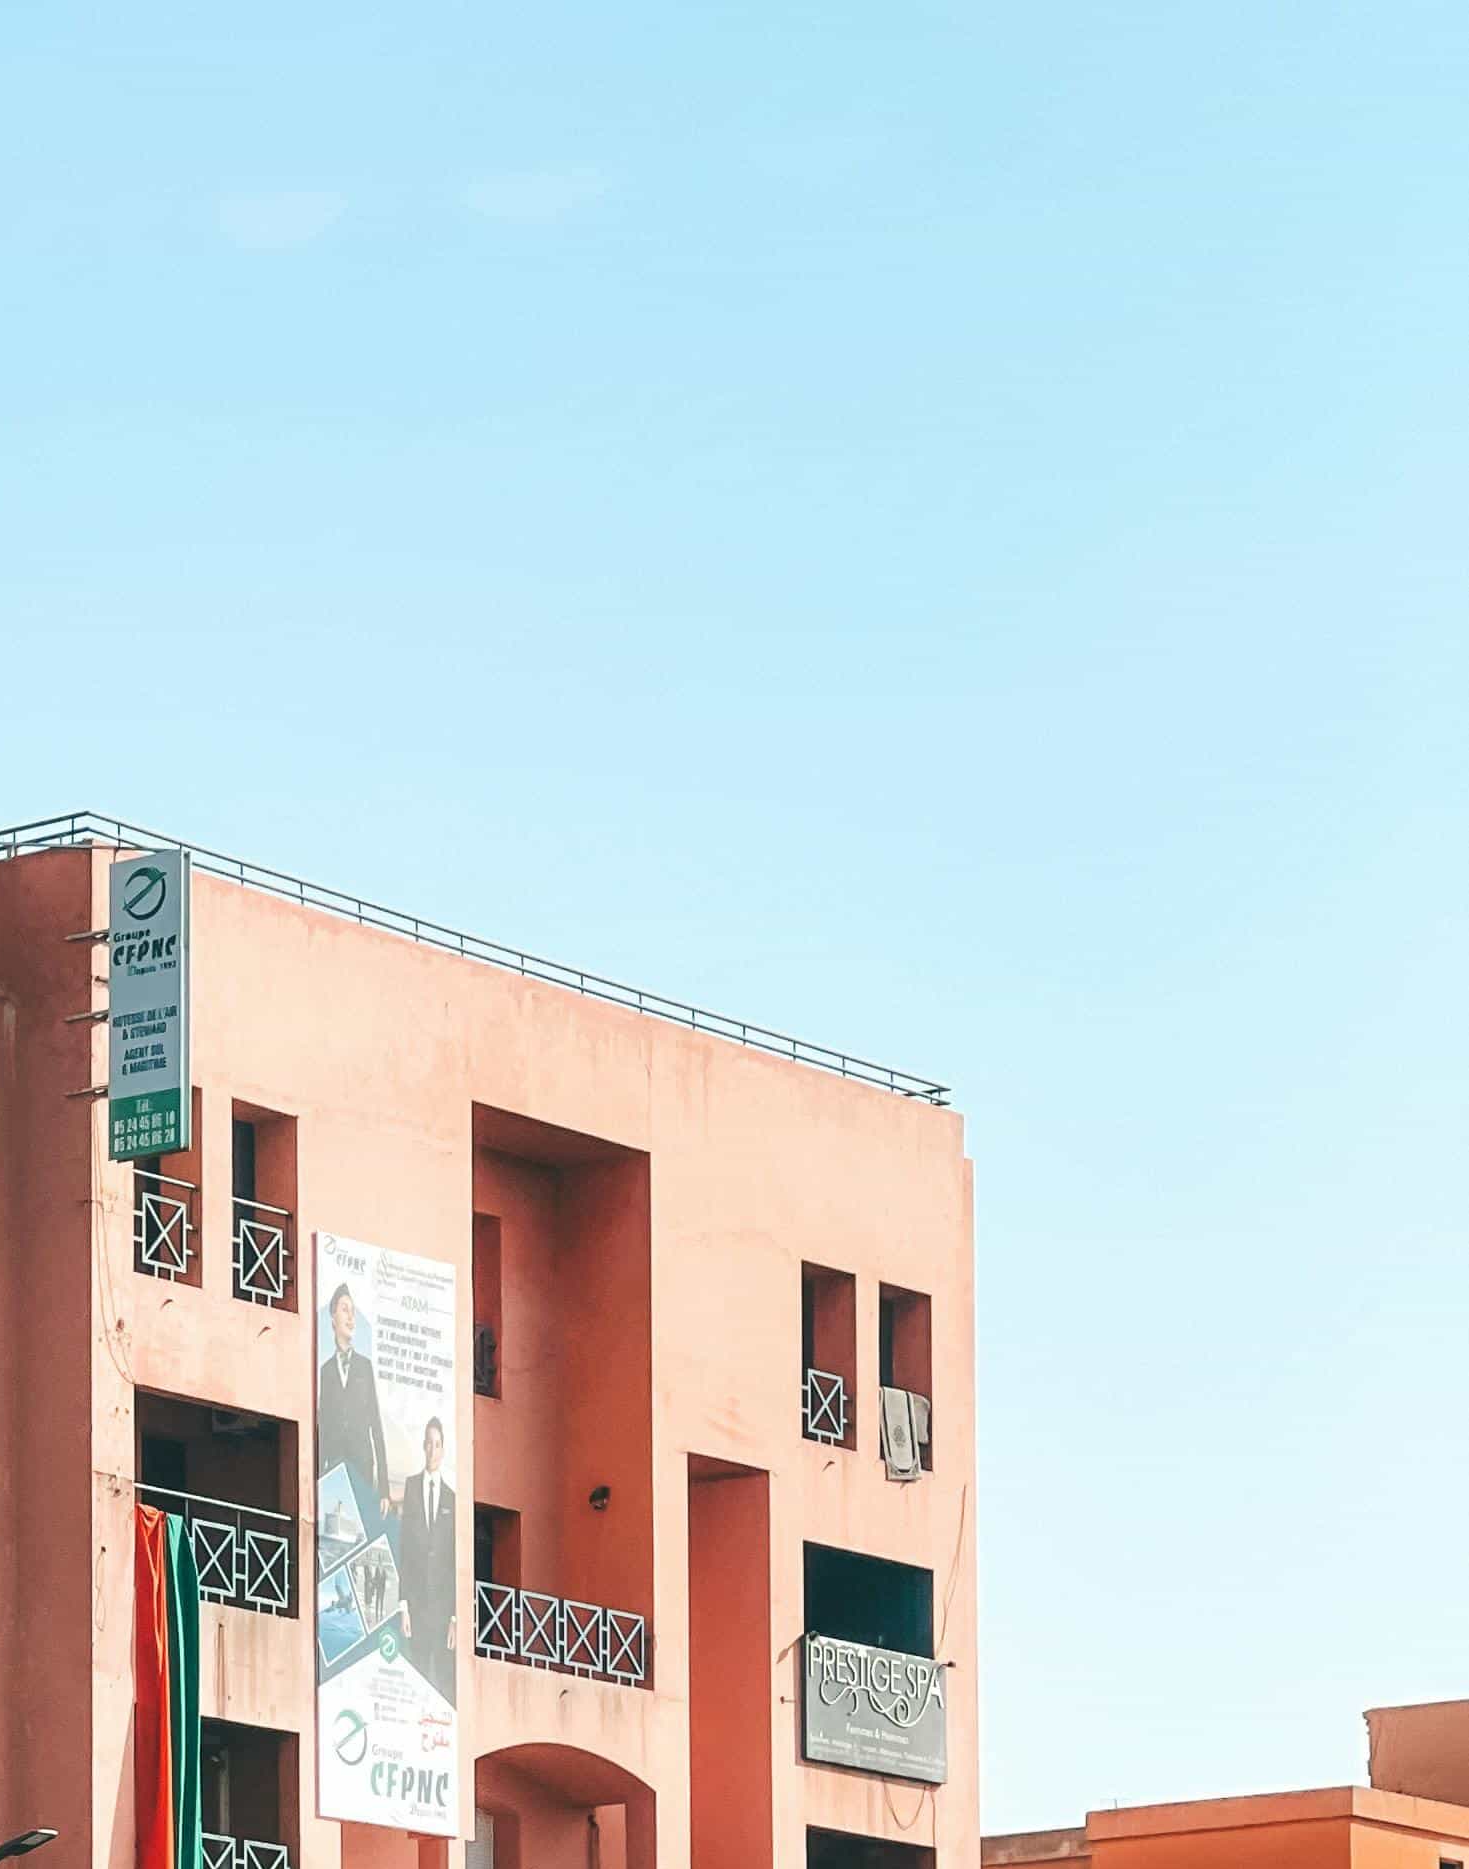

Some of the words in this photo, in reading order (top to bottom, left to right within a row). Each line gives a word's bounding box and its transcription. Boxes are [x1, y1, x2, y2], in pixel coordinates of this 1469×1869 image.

[113, 929, 151, 943] Groupe
[113, 934, 177, 967] CFPNC
[810, 1641, 903, 1696] PRESTIGE
[905, 1662, 944, 1709] SPA
[370, 1760, 450, 1808] CFPNC
